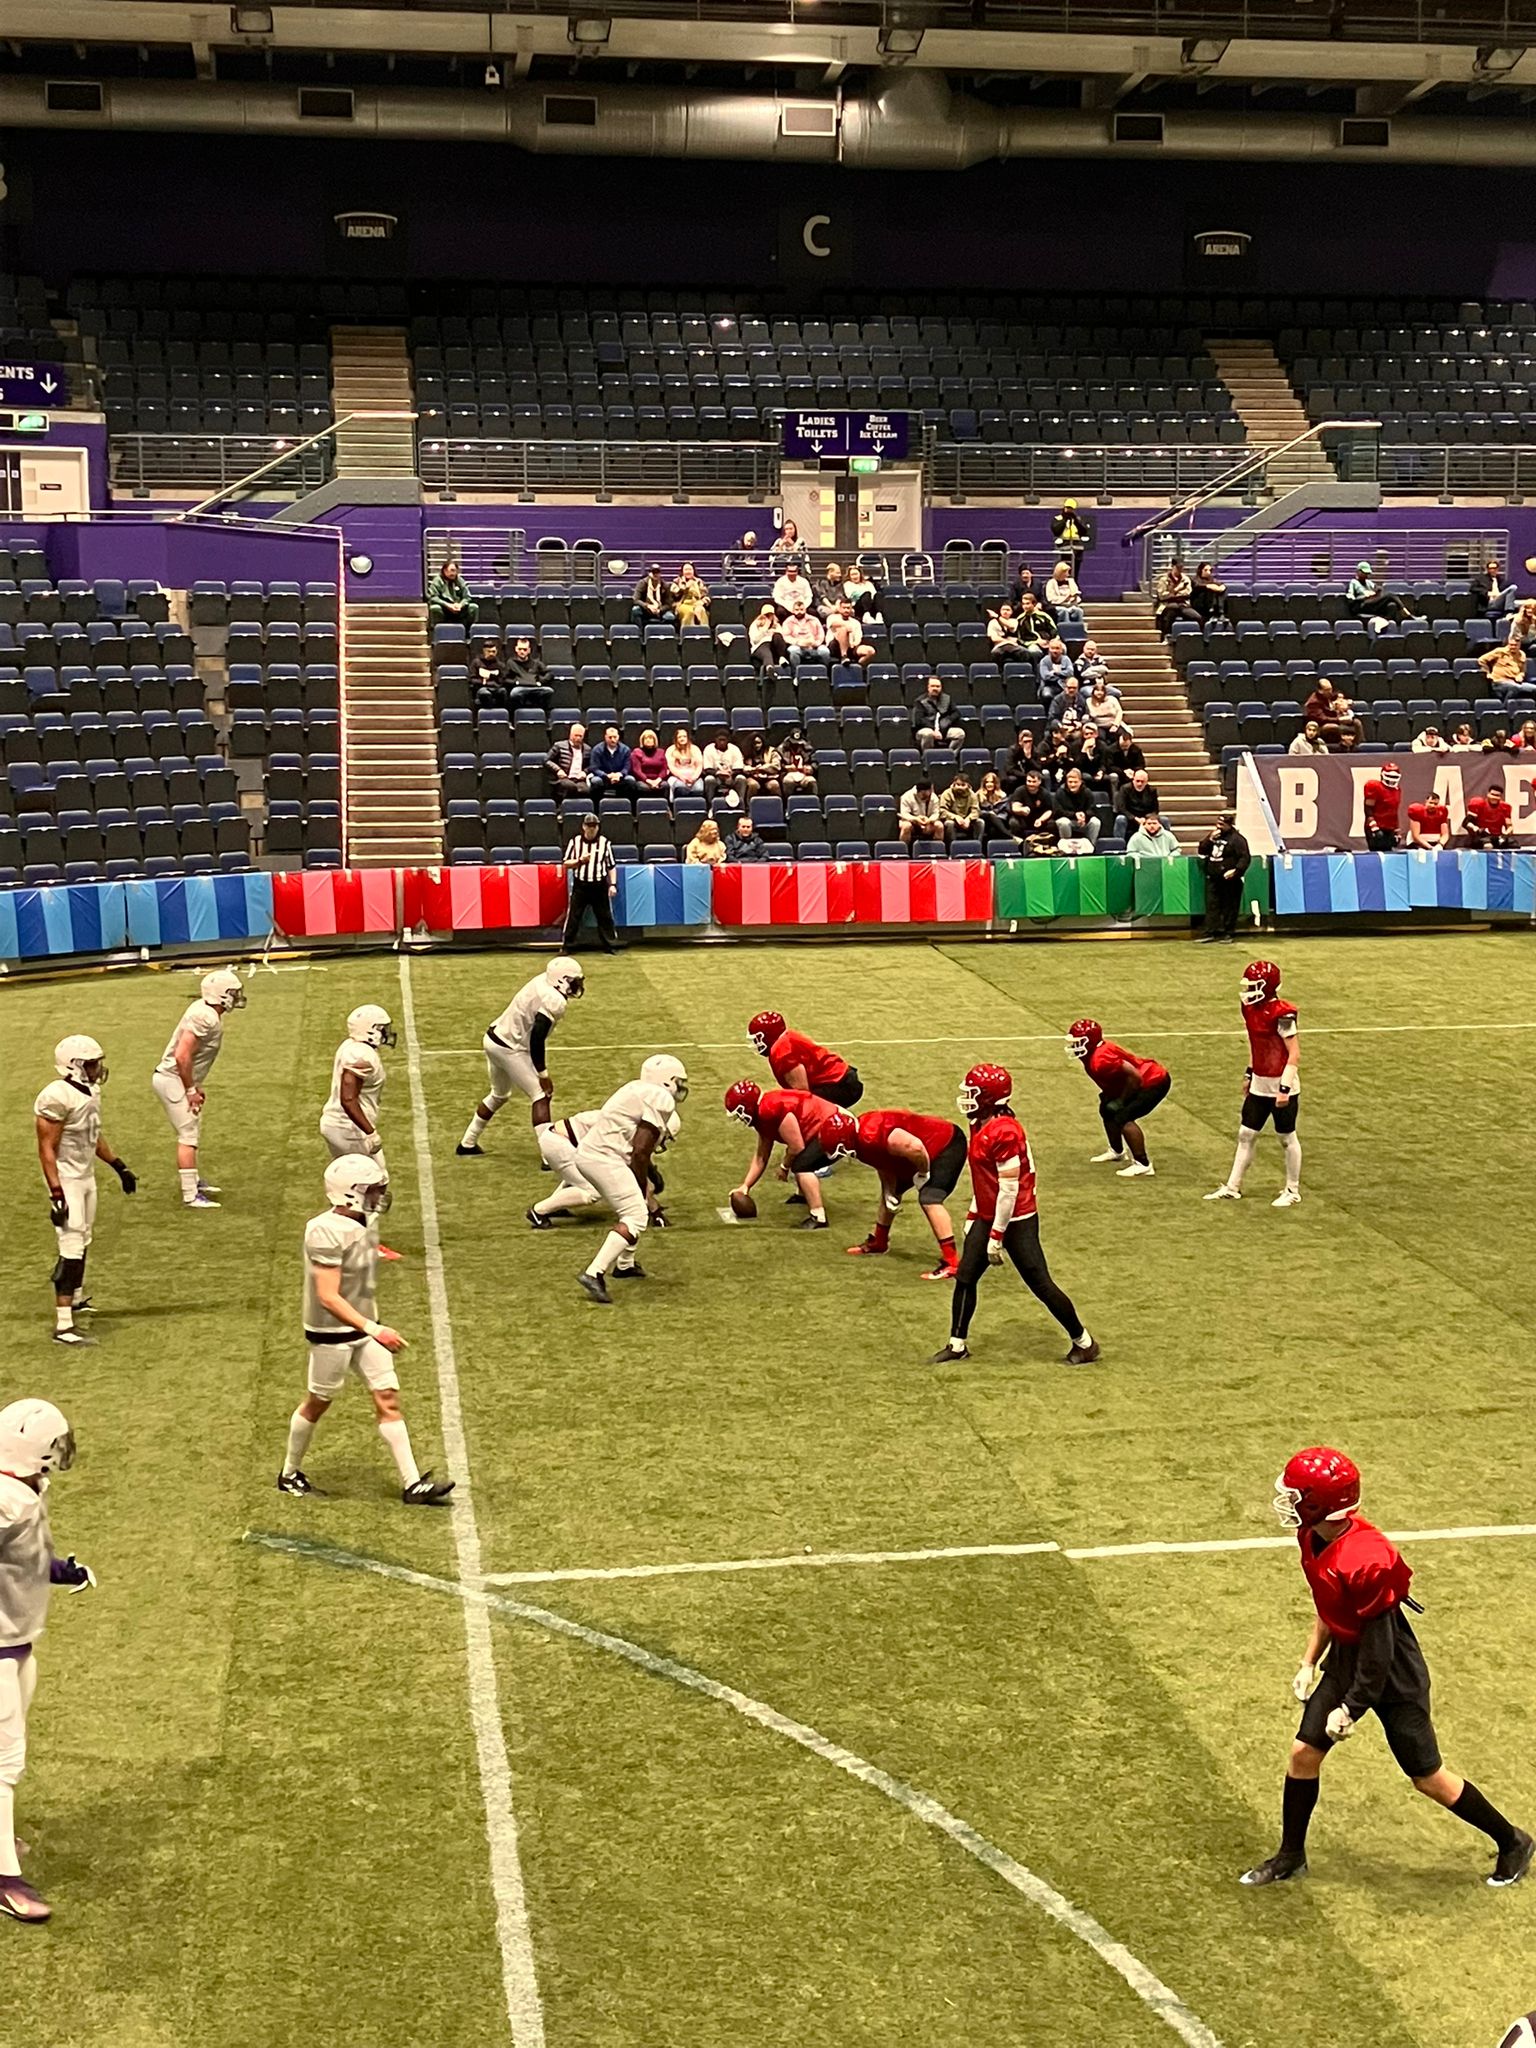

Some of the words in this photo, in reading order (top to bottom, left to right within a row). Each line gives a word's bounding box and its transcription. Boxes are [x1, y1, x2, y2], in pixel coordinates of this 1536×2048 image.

[346, 225, 386, 238] ARENA
[803, 214, 831, 257] C
[1204, 243, 1241, 256] ARENA
[799, 413, 836, 426] LADIES
[795, 426, 838, 438] TOILETS
